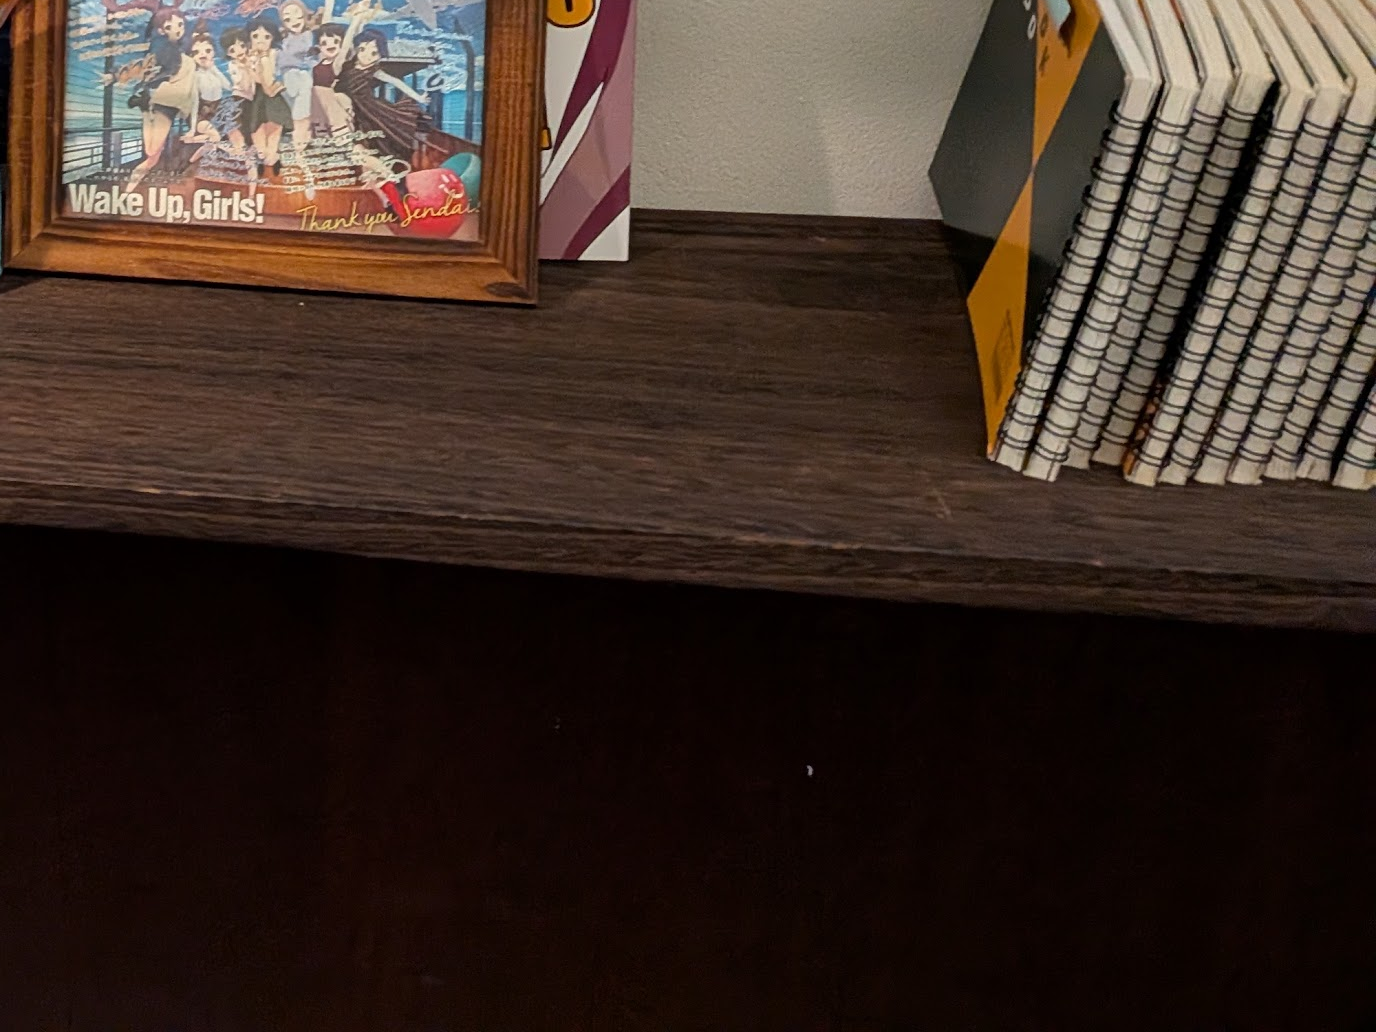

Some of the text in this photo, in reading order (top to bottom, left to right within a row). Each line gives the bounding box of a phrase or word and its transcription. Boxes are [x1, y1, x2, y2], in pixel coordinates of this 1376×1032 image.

[69, 183, 265, 224] Wake Up, Girls!
[296, 201, 361, 232] Thank
[364, 212, 399, 233] you
